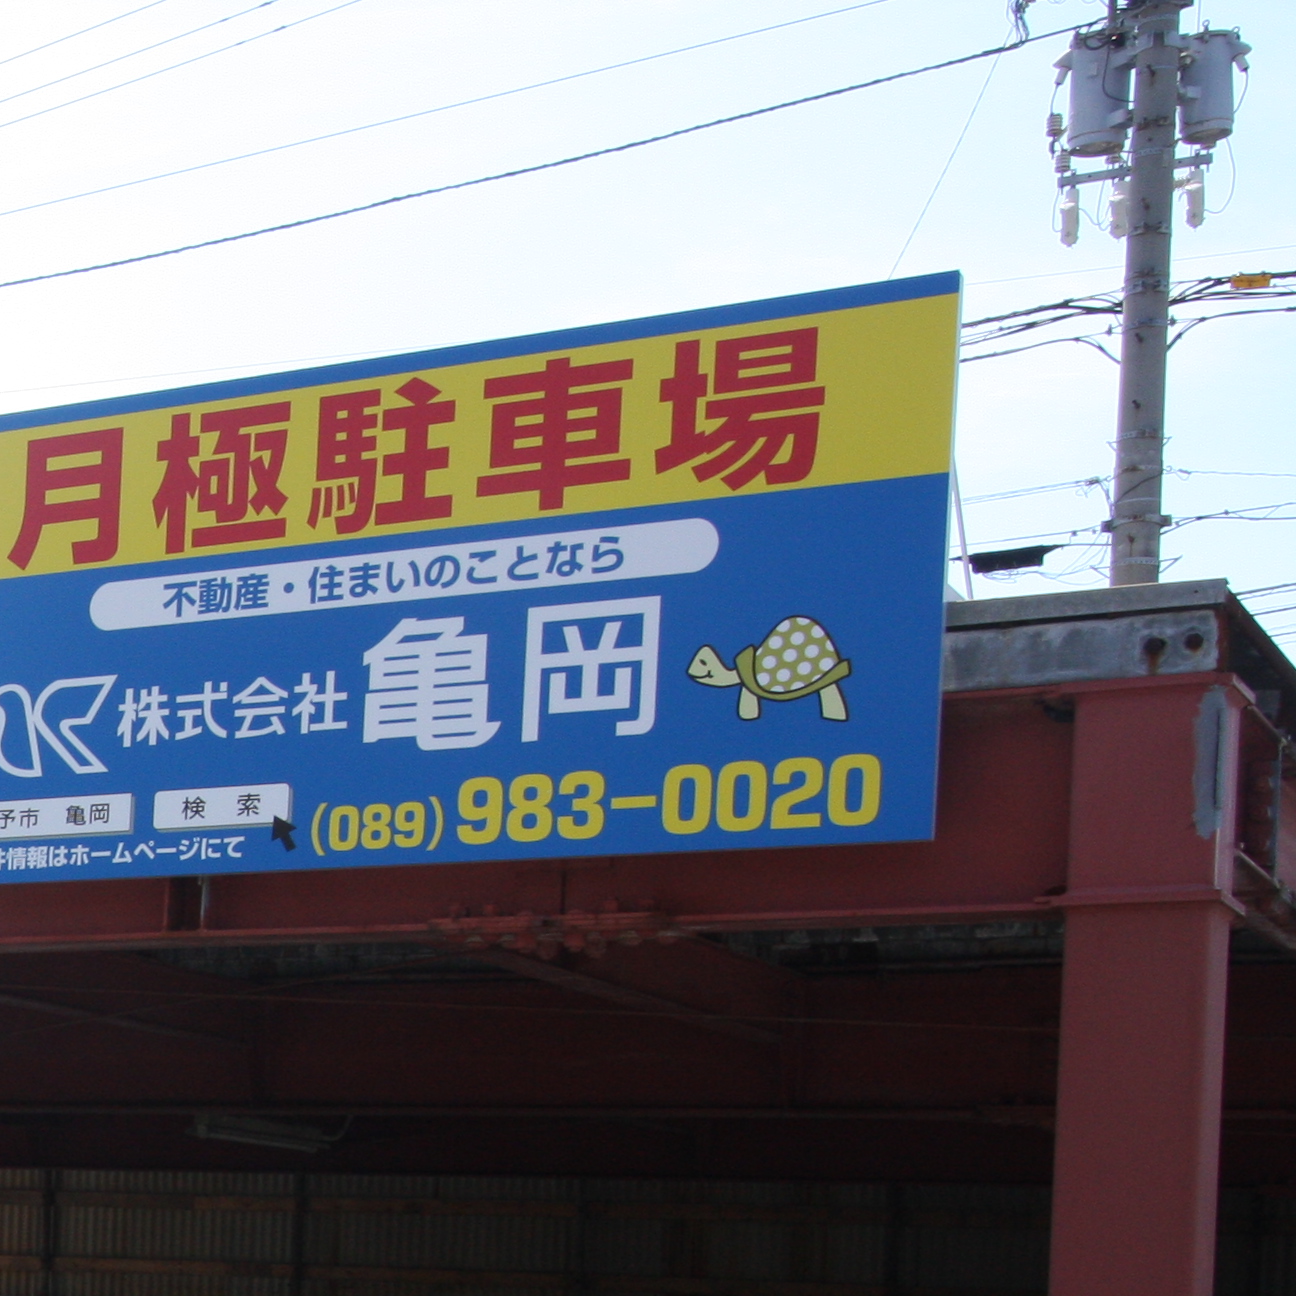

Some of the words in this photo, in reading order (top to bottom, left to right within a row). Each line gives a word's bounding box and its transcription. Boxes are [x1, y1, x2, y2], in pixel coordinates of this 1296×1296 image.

[8, 326, 825, 571] 月極駐車場
[163, 535, 625, 618] 不動産・住まいのことなら
